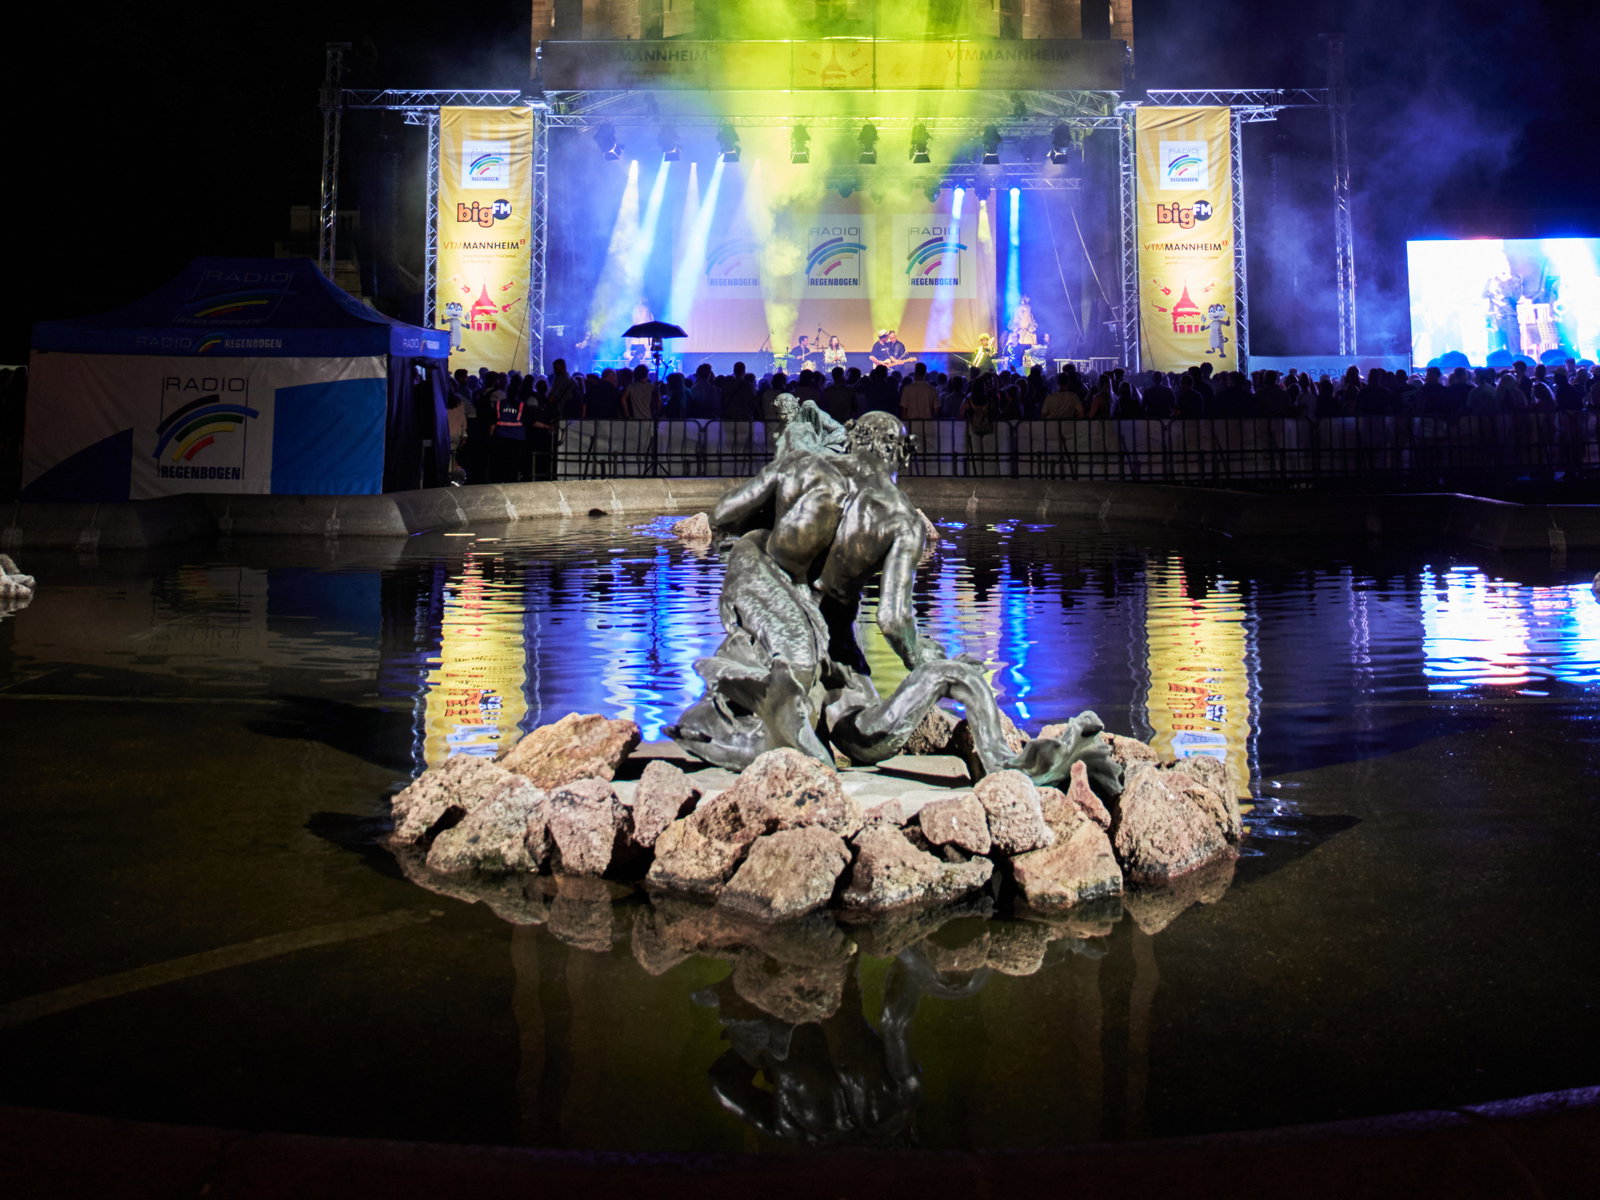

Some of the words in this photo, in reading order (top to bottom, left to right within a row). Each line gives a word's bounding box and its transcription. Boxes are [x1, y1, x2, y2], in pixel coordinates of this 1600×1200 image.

[588, 50, 709, 62] MANNHEIM
[810, 227, 859, 236] RADIO
[910, 227, 958, 236] RADIO
[206, 270, 289, 283] RADIO
[709, 278, 758, 287] REGENBOGEN
[810, 278, 859, 286] REGENBOGEN
[910, 278, 959, 286] REGENBOGEN
[136, 336, 192, 349] RADIO
[224, 338, 282, 349] REGENBOGEN
[166, 377, 245, 391] RADIO
[161, 466, 240, 480] REGENBOGEN
